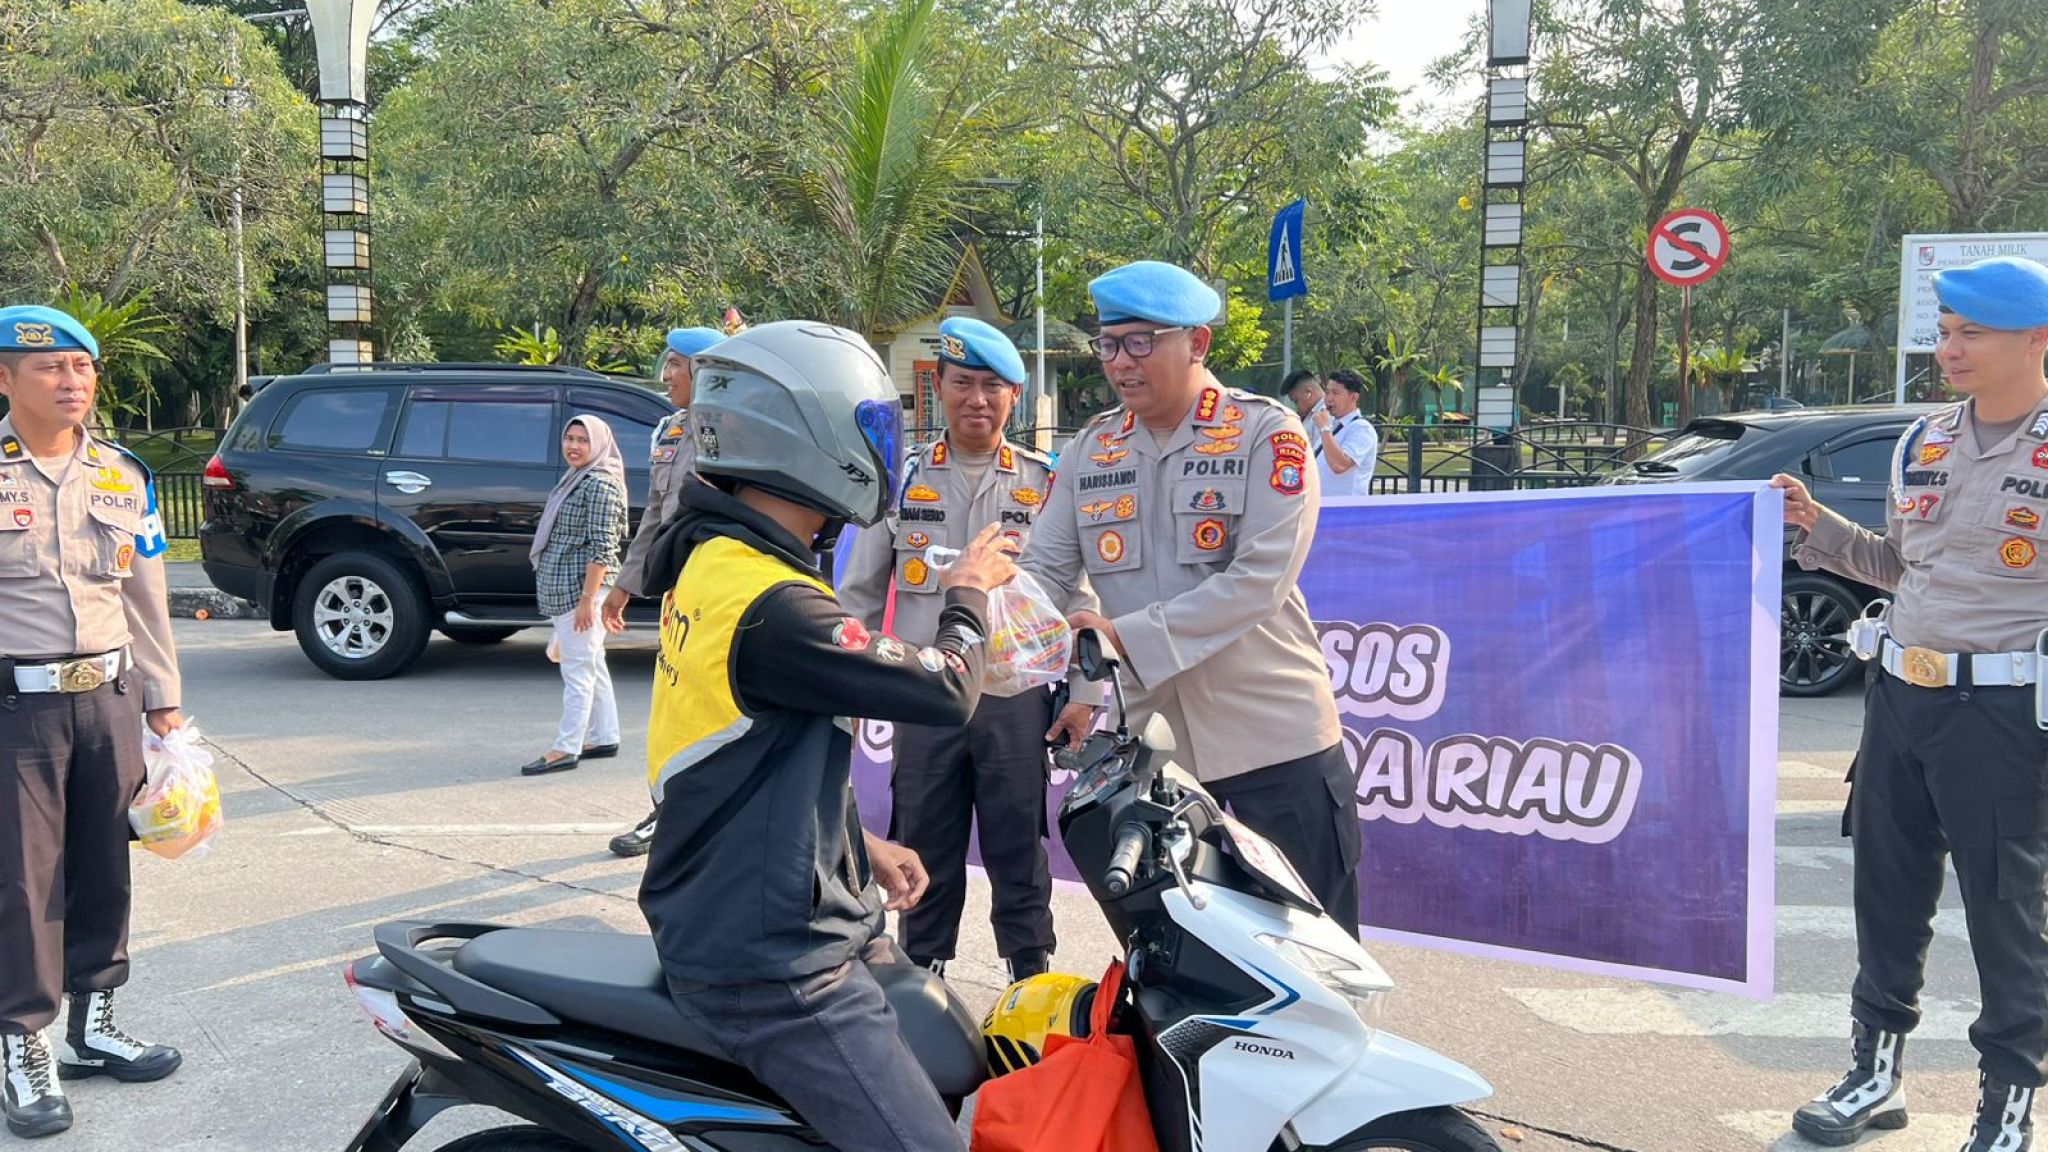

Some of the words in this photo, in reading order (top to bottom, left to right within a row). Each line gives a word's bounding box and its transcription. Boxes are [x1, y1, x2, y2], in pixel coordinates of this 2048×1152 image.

[1960, 244, 1995, 257] TANAH
[1999, 243, 2027, 256] MILIK
[838, 462, 876, 487] JPX
[1183, 458, 1244, 476] POLRI
[2000, 475, 2048, 499] POL
[0, 490, 30, 503] MY.S
[91, 494, 138, 510] POLRI
[1001, 510, 1032, 525] POL
[1319, 625, 1438, 702] SOS
[1430, 738, 1627, 823] RIAU
[1233, 1041, 1295, 1060] HONDA
